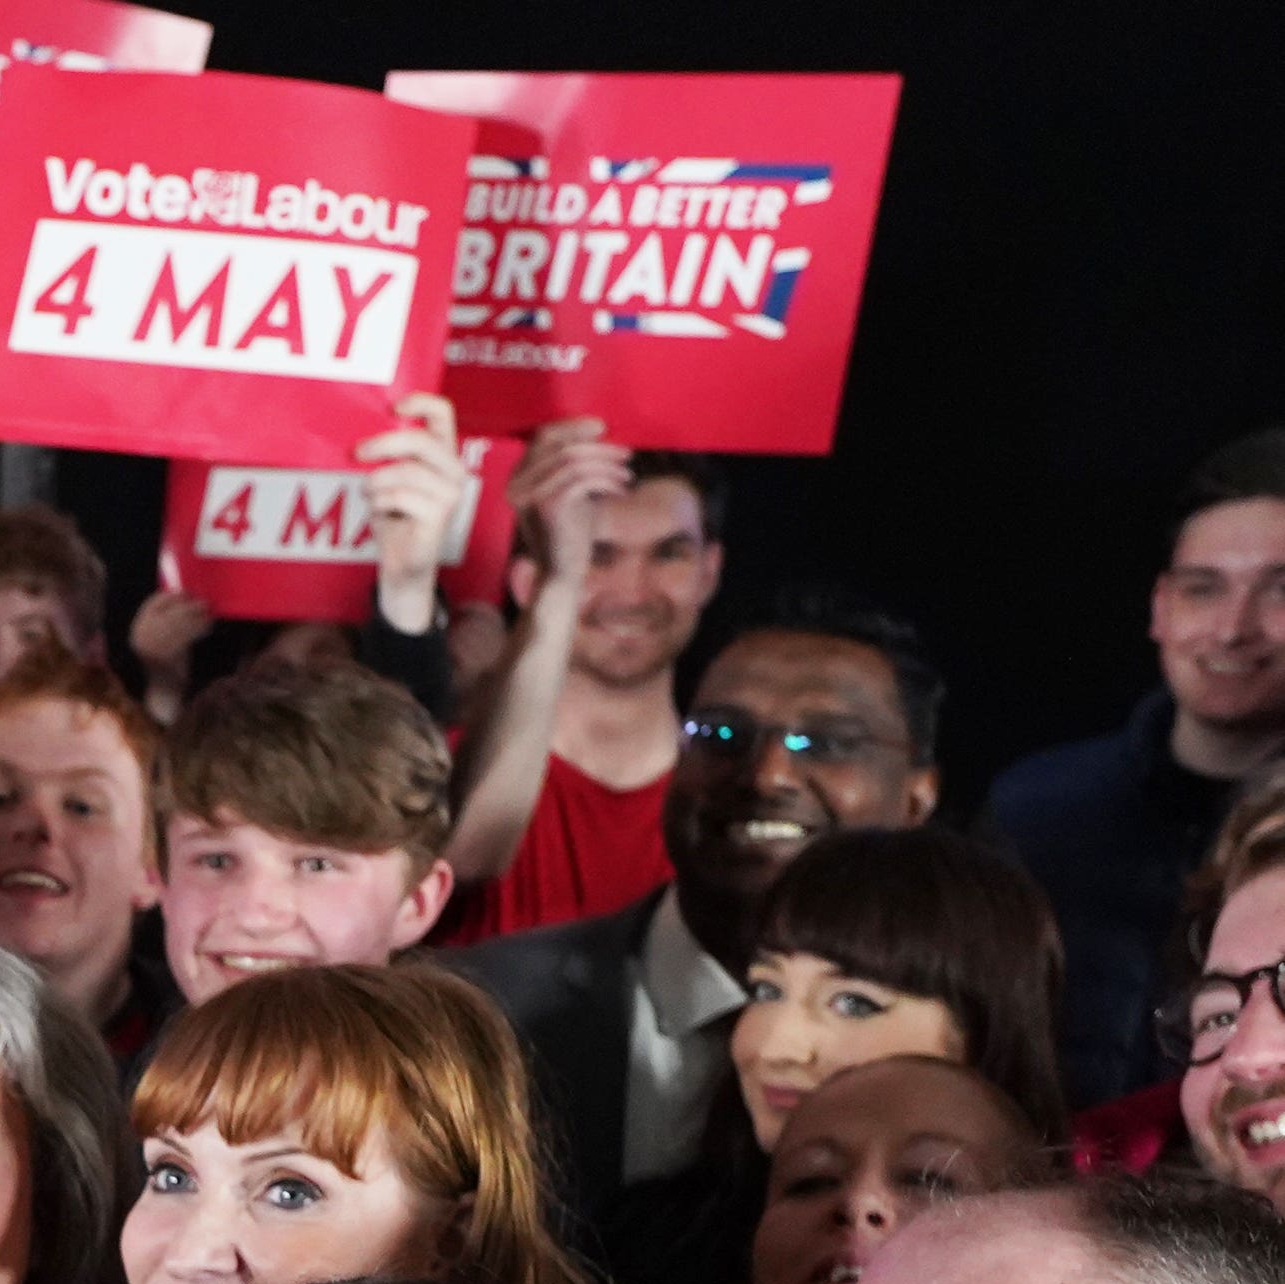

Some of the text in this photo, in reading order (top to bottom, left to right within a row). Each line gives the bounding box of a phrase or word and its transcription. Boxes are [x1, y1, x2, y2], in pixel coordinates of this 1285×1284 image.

[45, 157, 428, 247] Vote Labour
[464, 183, 788, 230] BUILD A BETTER
[33, 244, 394, 361] 4 MAY
[453, 230, 775, 307] BRITAIN
[211, 482, 253, 544] 4
